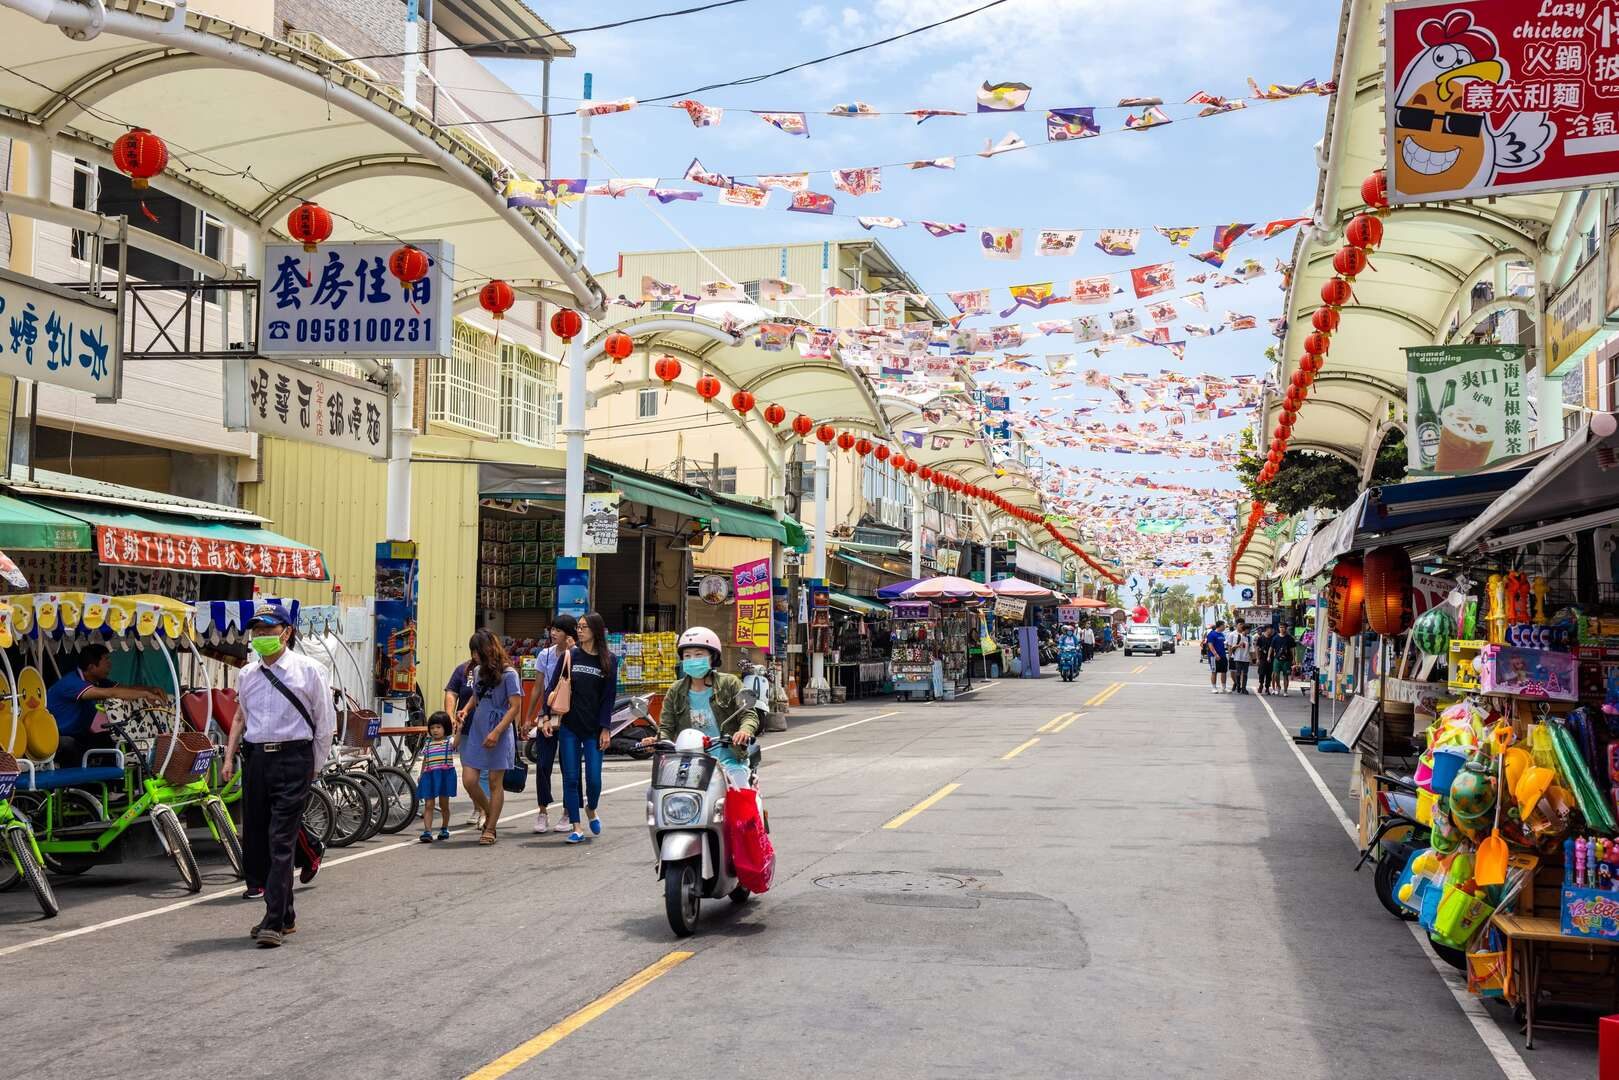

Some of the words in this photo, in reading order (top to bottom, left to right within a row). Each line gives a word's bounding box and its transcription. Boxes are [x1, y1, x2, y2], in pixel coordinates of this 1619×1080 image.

[1537, 0, 1585, 19] Lazy
[1512, 20, 1585, 39] chicken
[1526, 45, 1582, 71] 火鍋
[1465, 82, 1580, 109] 義大利麵
[1565, 112, 1617, 136] 冷氣
[296, 318, 432, 342] 0958100231
[1419, 354, 1462, 363] dumpling
[1461, 368, 1499, 391] 爽口
[1503, 363, 1521, 454] 海尼根綠茶
[194, 758, 210, 771] 028
